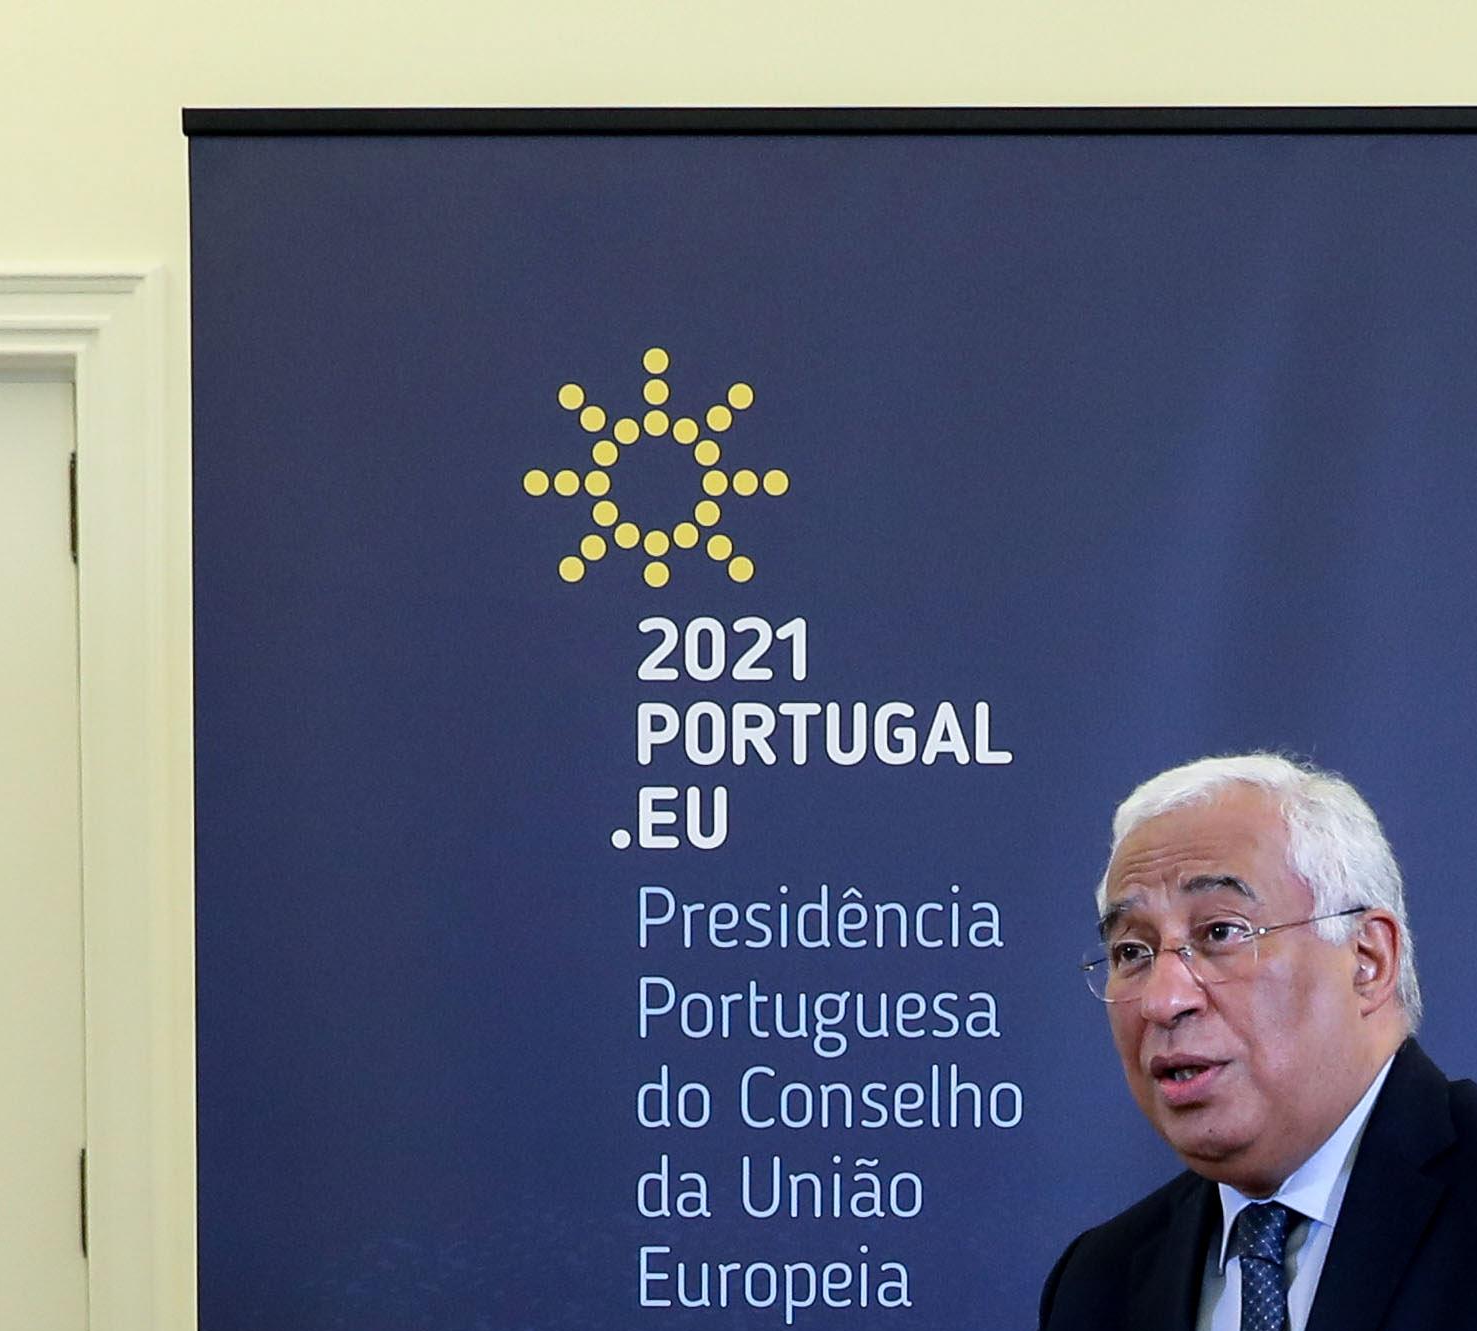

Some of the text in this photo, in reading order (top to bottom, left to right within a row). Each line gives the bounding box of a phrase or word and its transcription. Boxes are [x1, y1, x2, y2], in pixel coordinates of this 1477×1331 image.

[637, 616, 808, 682] 2021
[637, 701, 1014, 766] PORTUGAL
[611, 786, 729, 850] .EU
[638, 884, 1005, 949] Presidência
[638, 976, 1002, 1058] Portuguesa
[636, 1063, 1024, 1130] do Conselho
[636, 1154, 924, 1219] da União
[638, 1245, 914, 1326] Europeia
